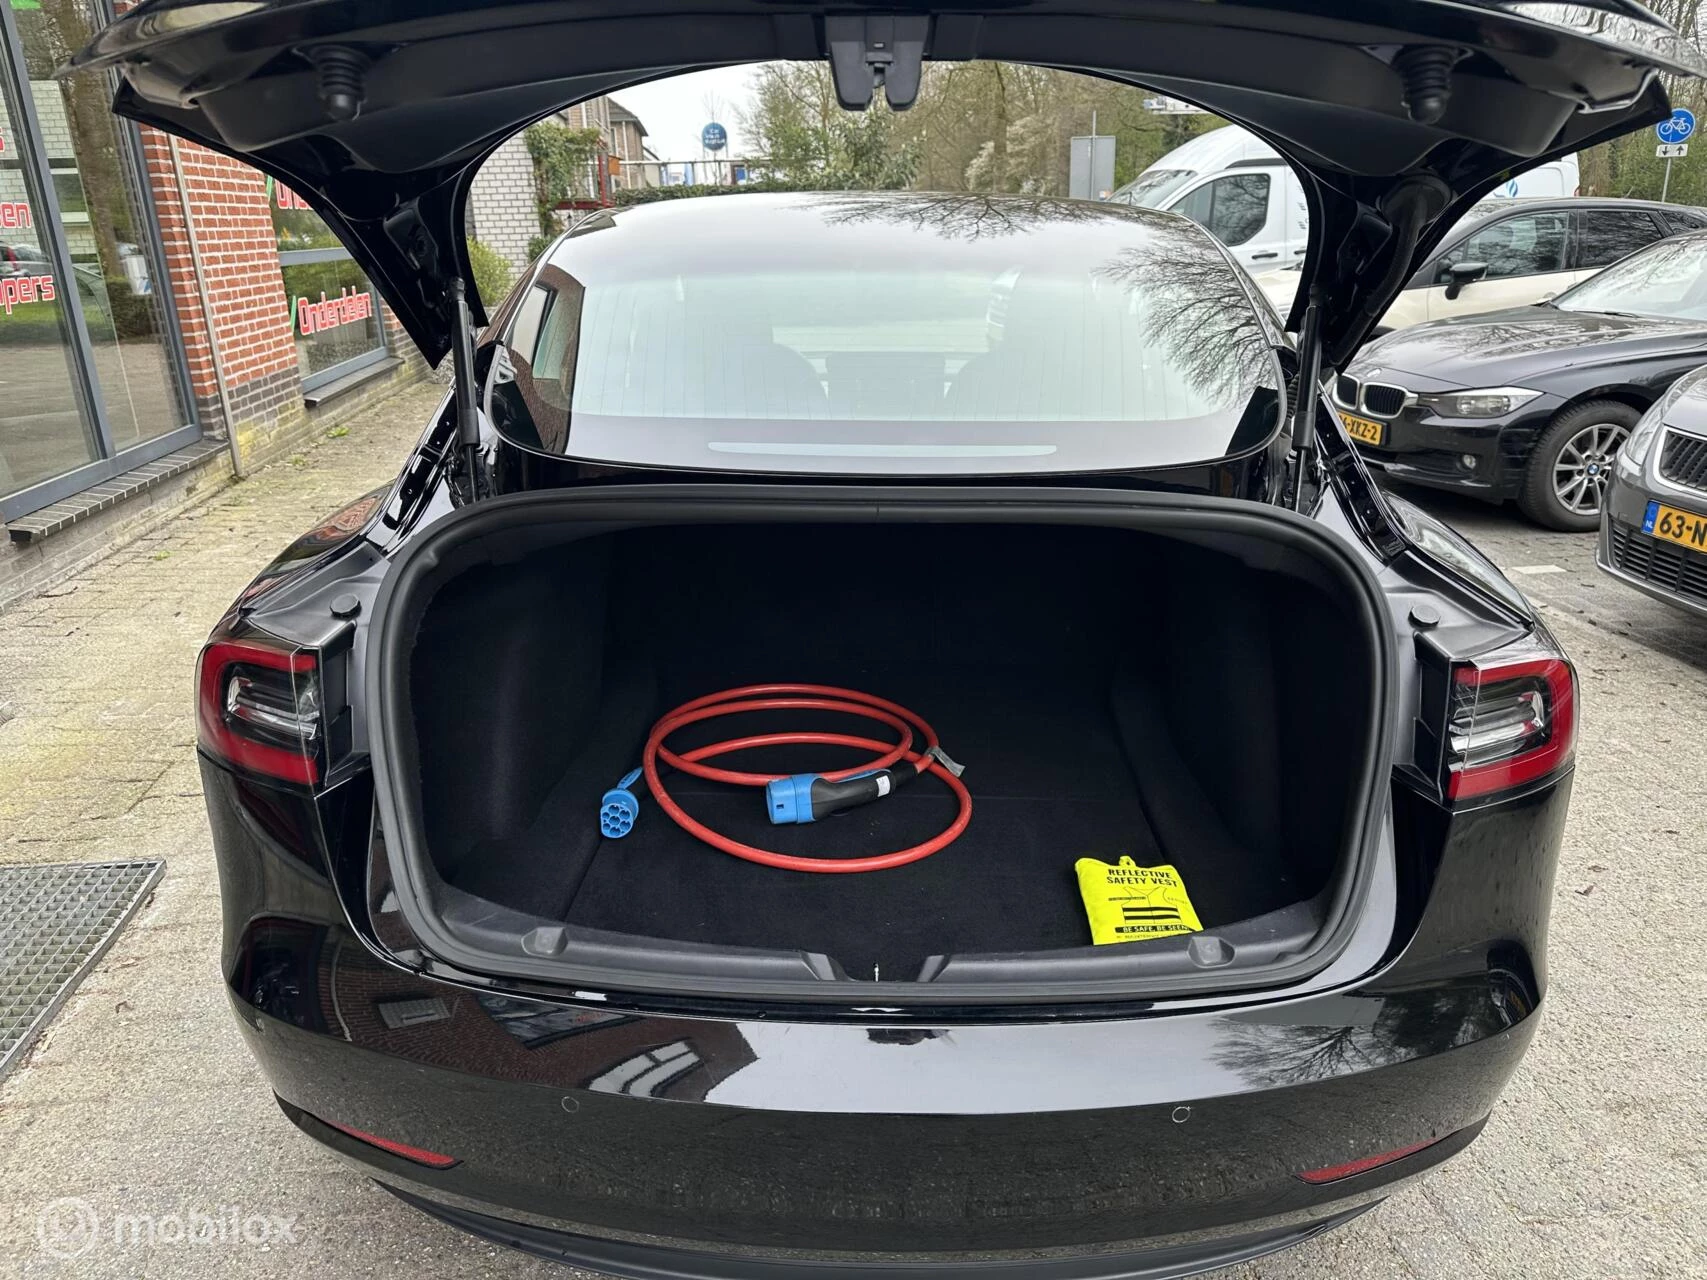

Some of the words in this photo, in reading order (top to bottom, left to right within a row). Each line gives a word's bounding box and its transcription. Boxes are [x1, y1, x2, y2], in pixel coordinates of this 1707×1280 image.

[0, 203, 31, 228] en
[0, 275, 55, 315] pers
[298, 286, 372, 335] Onderdelen
[1645, 520, 1653, 529] NL
[1108, 869, 1171, 879] REFLECTIVE
[1151, 878, 1177, 887] VEST
